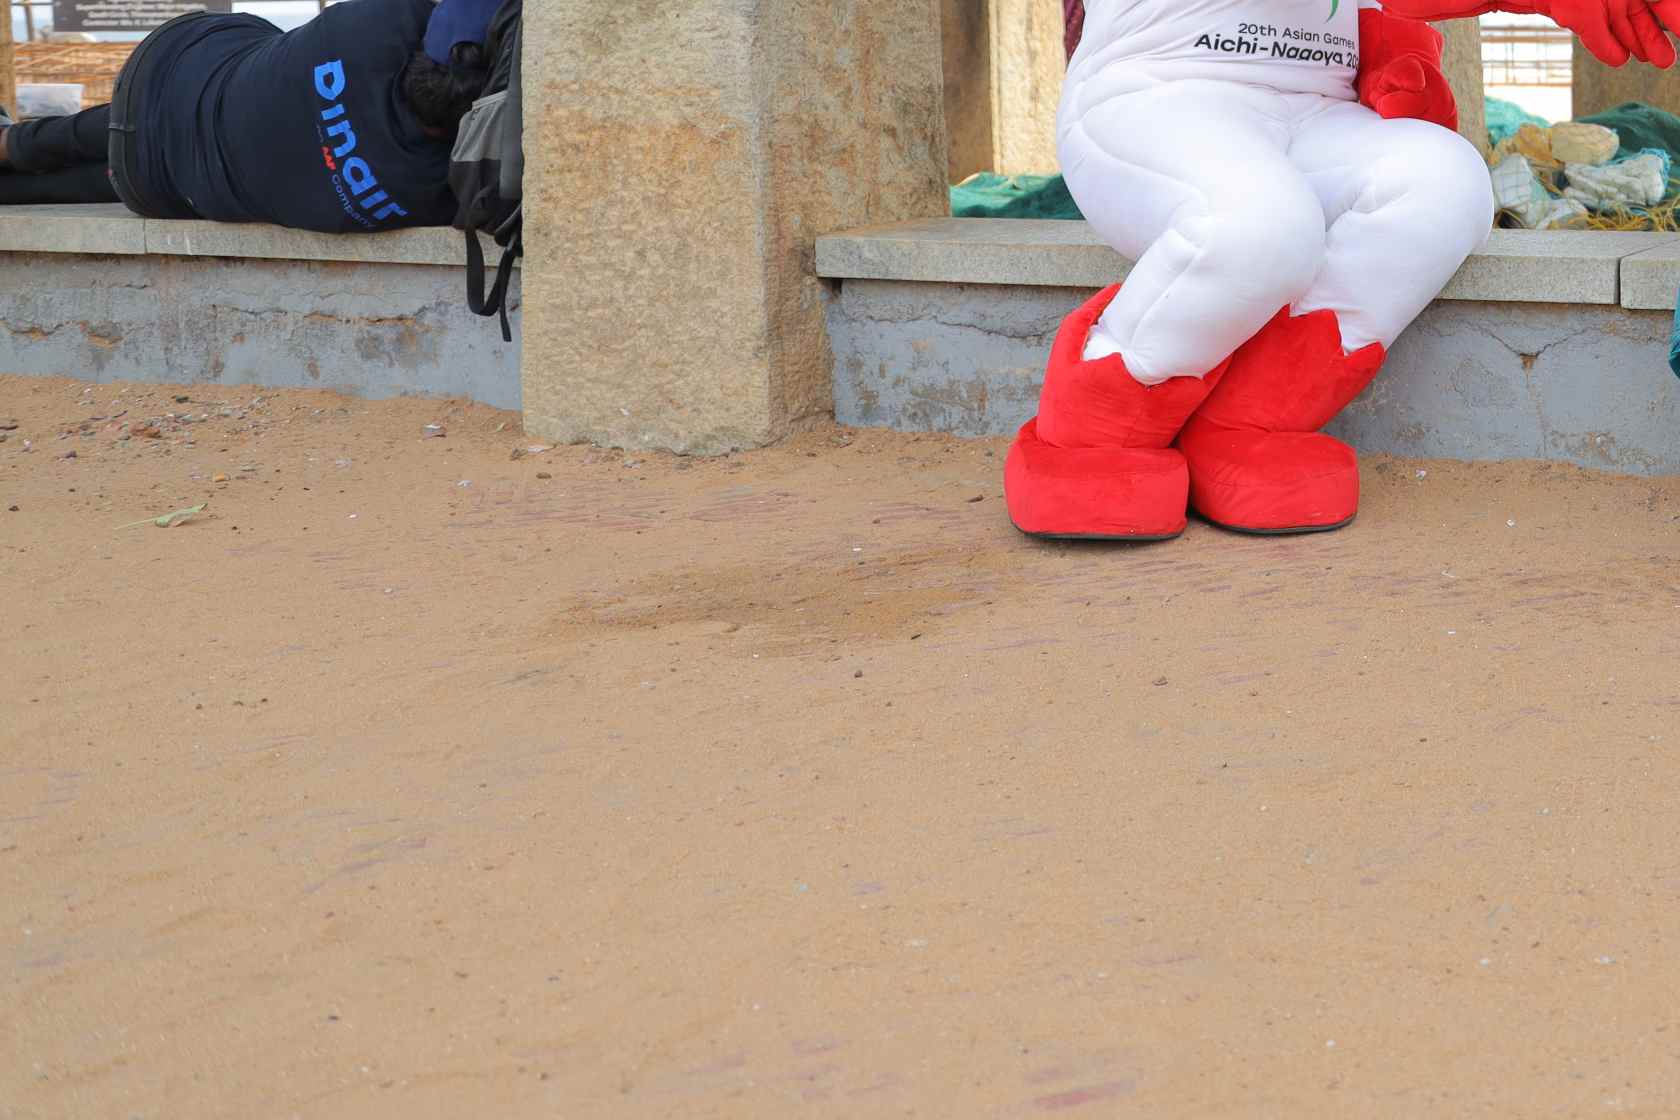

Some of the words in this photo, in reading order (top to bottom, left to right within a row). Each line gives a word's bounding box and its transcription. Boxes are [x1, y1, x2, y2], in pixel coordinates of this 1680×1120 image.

[1238, 23, 1277, 37] 20th
[1282, 27, 1320, 43] Asian
[313, 59, 409, 221] Dinair
